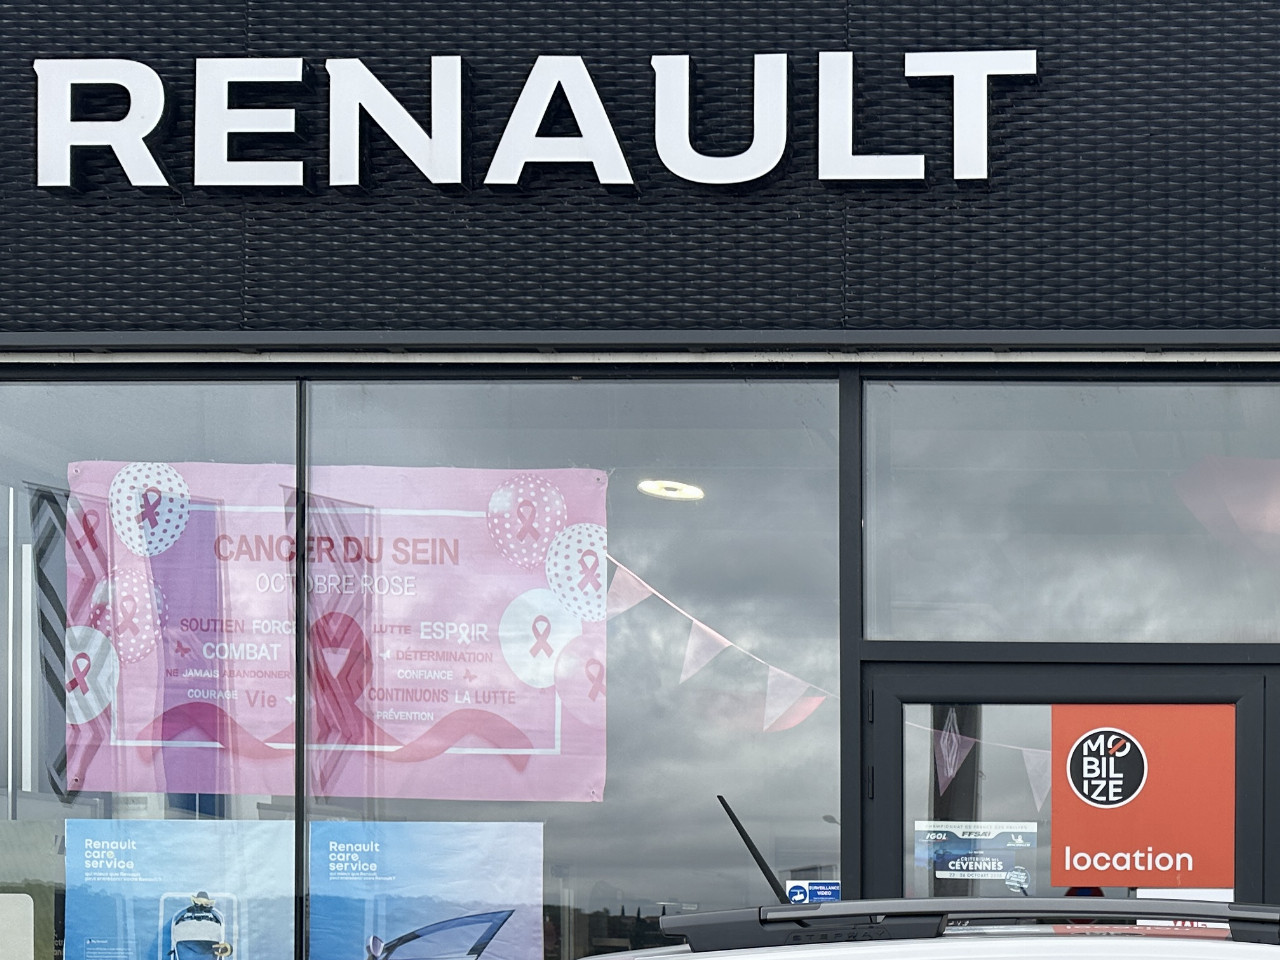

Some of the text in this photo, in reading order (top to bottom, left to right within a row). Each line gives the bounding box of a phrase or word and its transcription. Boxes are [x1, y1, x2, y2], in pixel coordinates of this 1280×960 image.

[33, 49, 1038, 189] RENAULT
[214, 534, 460, 566] CANCER DU SEIN
[361, 576, 417, 596] ROSE
[180, 617, 245, 634] SOUTIEN
[373, 623, 412, 635] LUTTE
[202, 641, 282, 661] COMBAT
[396, 646, 493, 663] DÉTERMINATION
[165, 668, 291, 679] NE JAMAIS ABANDONNER
[397, 669, 454, 681] CONFIANCE
[187, 688, 278, 708] COURAGE Vie
[368, 687, 516, 705] CONTINUONS LA LUTTE
[376, 707, 434, 721] PRÉVENTION
[925, 832, 948, 840] IGOL
[84, 838, 137, 850] Renault
[329, 840, 380, 852] Renault
[84, 850, 115, 859] care
[328, 852, 359, 861] care
[1064, 845, 1193, 871] location
[84, 858, 135, 869] service
[328, 860, 377, 871] service
[948, 858, 1004, 871] CÉVENNES
[791, 930, 886, 943] STEPWAY
